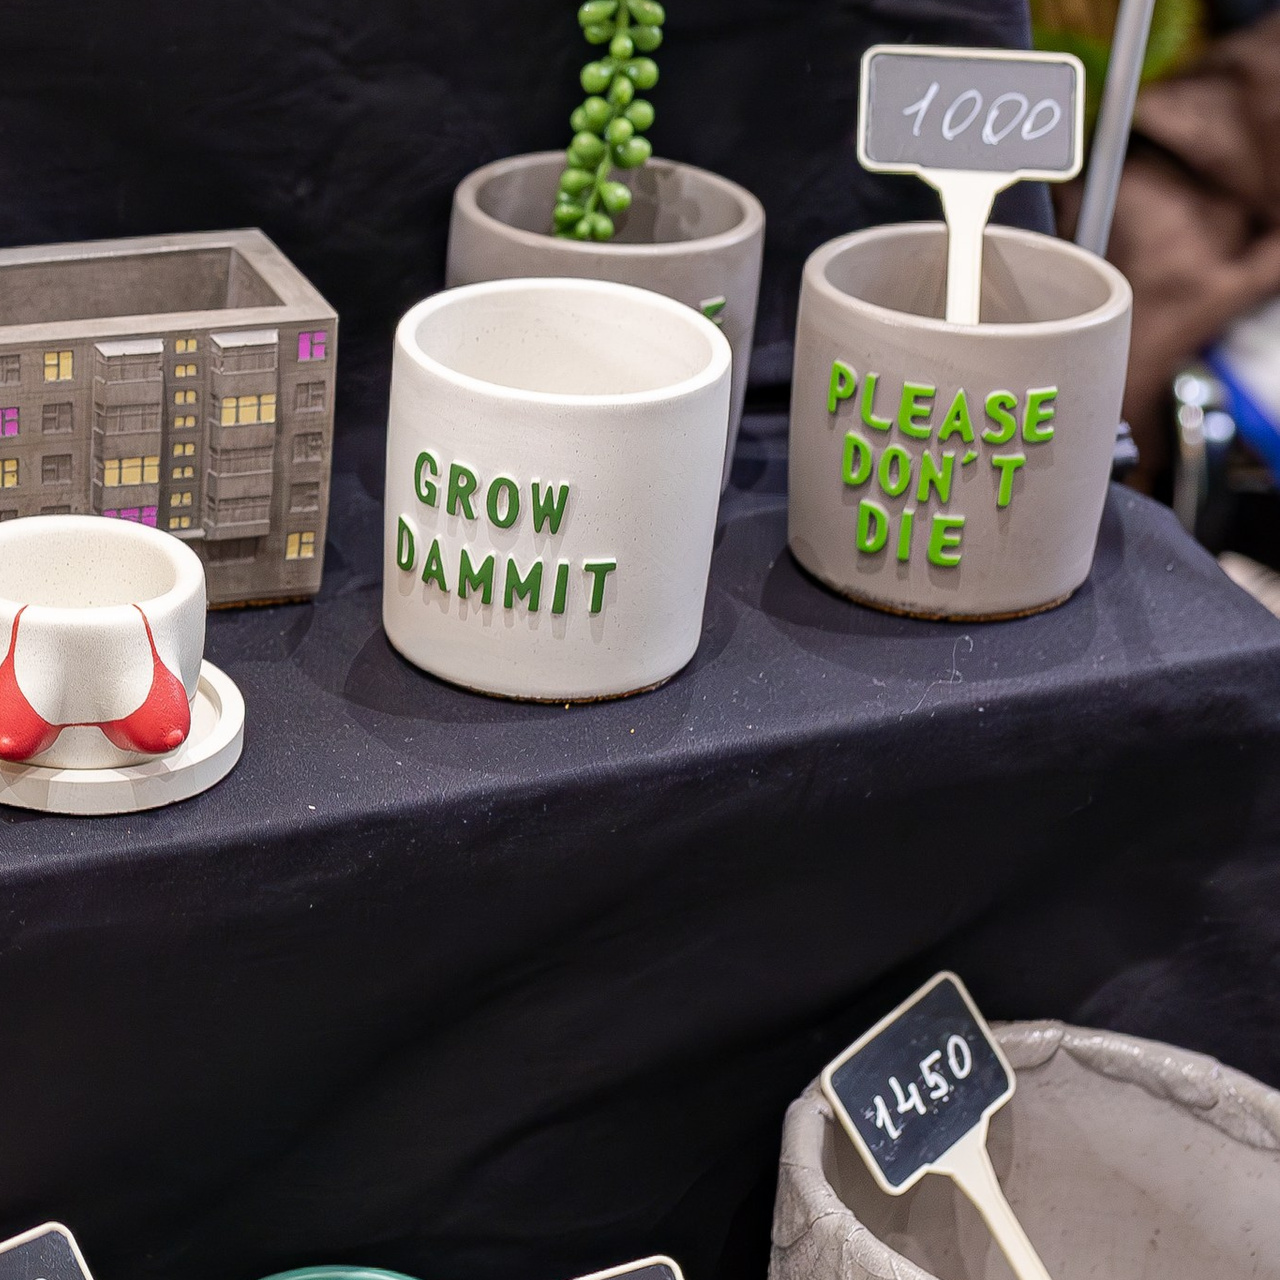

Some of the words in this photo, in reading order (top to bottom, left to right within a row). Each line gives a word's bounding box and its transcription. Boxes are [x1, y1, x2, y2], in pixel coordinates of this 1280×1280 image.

[901, 78, 1062, 146] 1000
[827, 359, 1059, 444] PLEASE
[414, 449, 570, 535] GROW
[841, 430, 1027, 507] DON'T
[396, 513, 618, 614] DAMMIT
[856, 499, 966, 567] DIE
[872, 1034, 972, 1140] 1450
